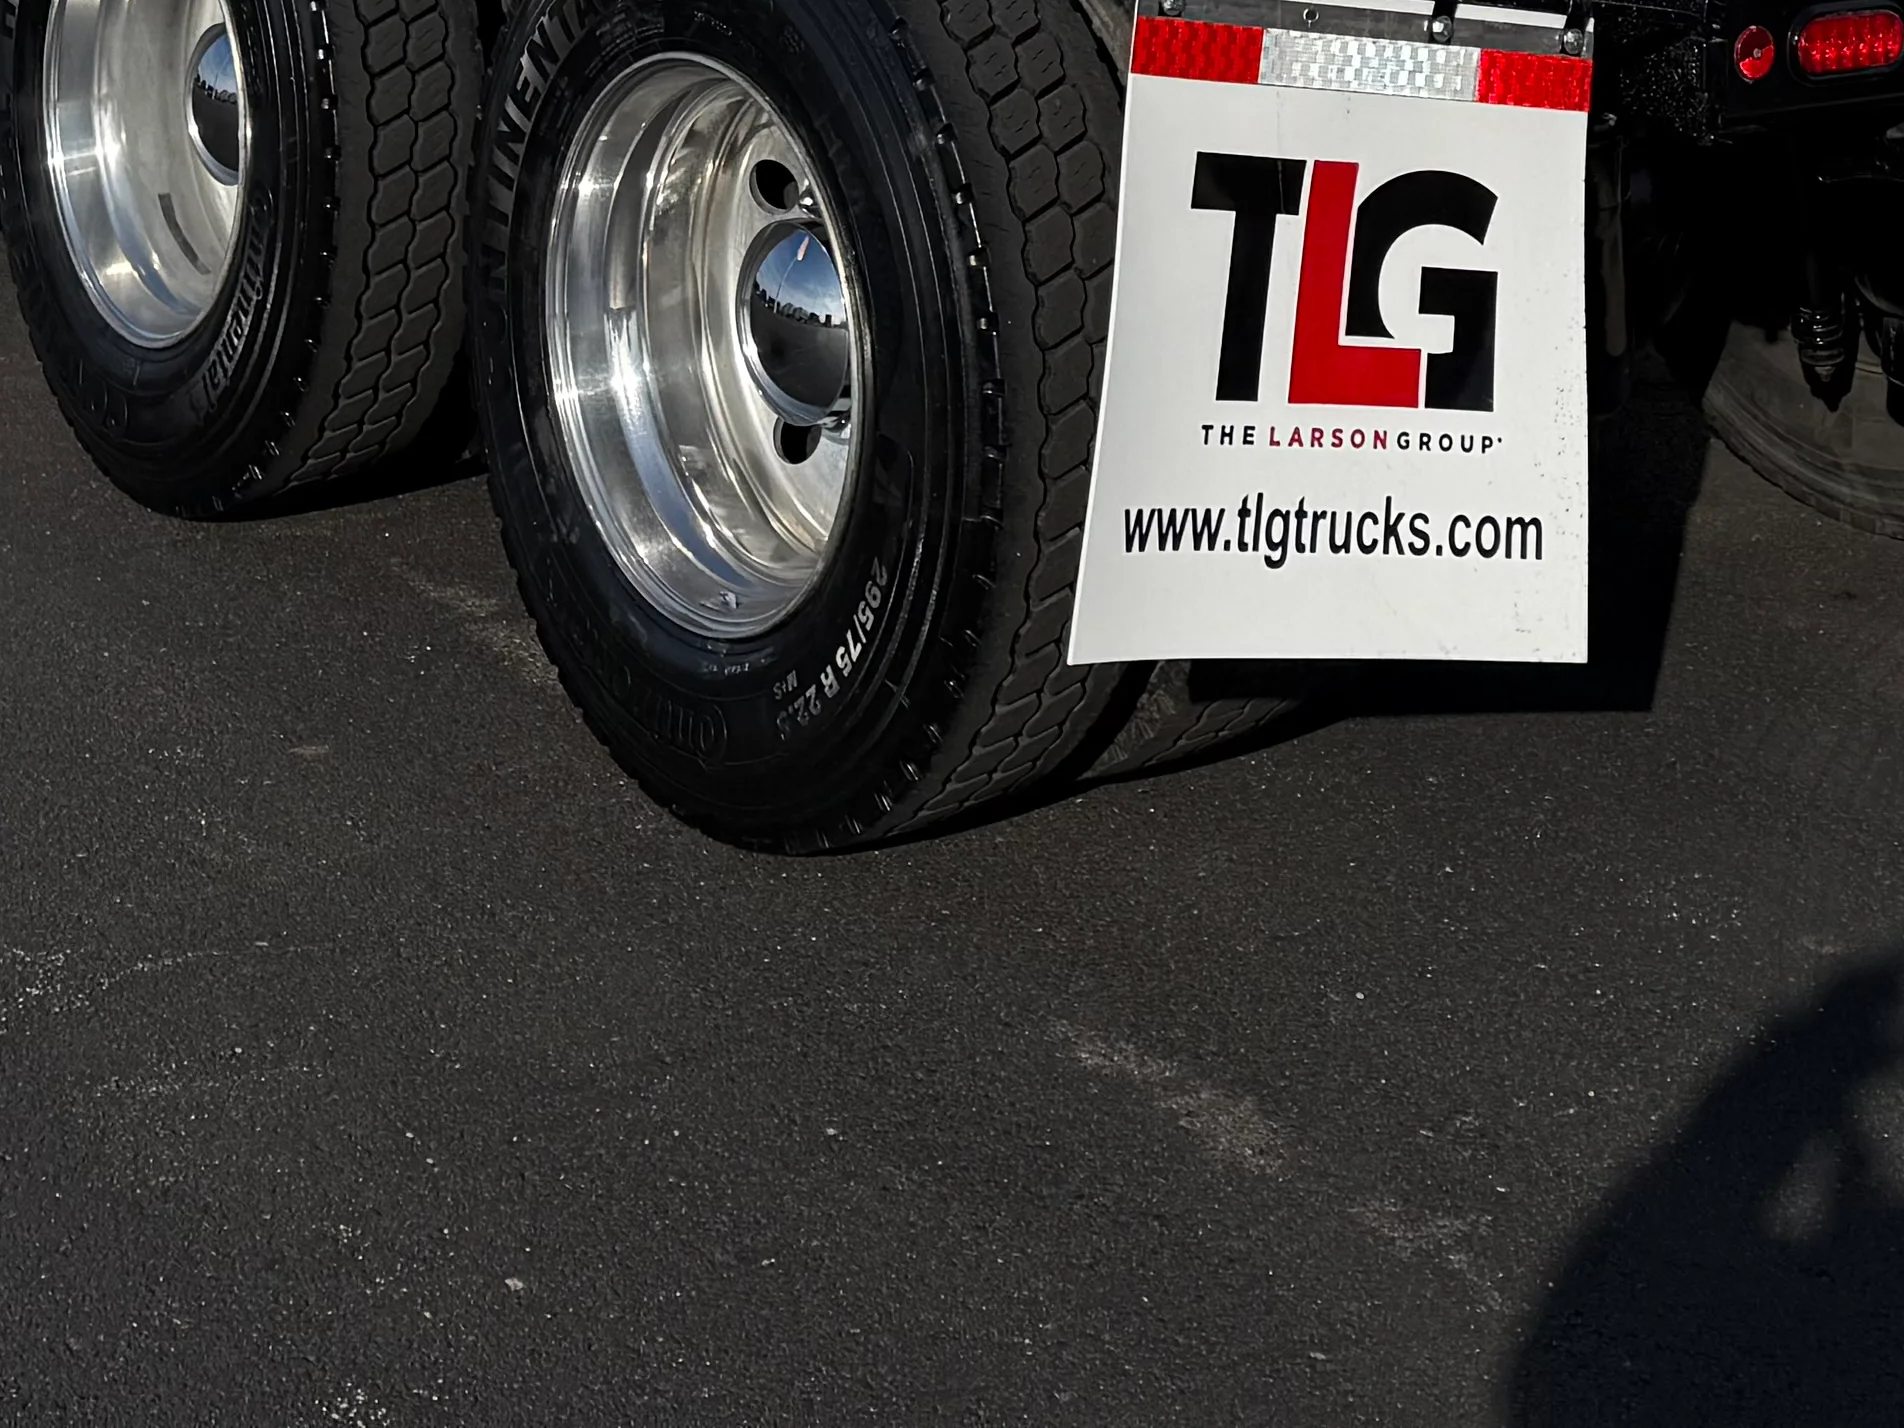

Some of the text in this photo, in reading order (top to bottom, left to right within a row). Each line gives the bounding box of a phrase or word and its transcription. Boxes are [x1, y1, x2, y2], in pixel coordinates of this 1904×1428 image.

[1191, 151, 1498, 412] TLG
[1201, 424, 1257, 445] THE
[1123, 491, 1543, 570] www.tlgtrucks.com
